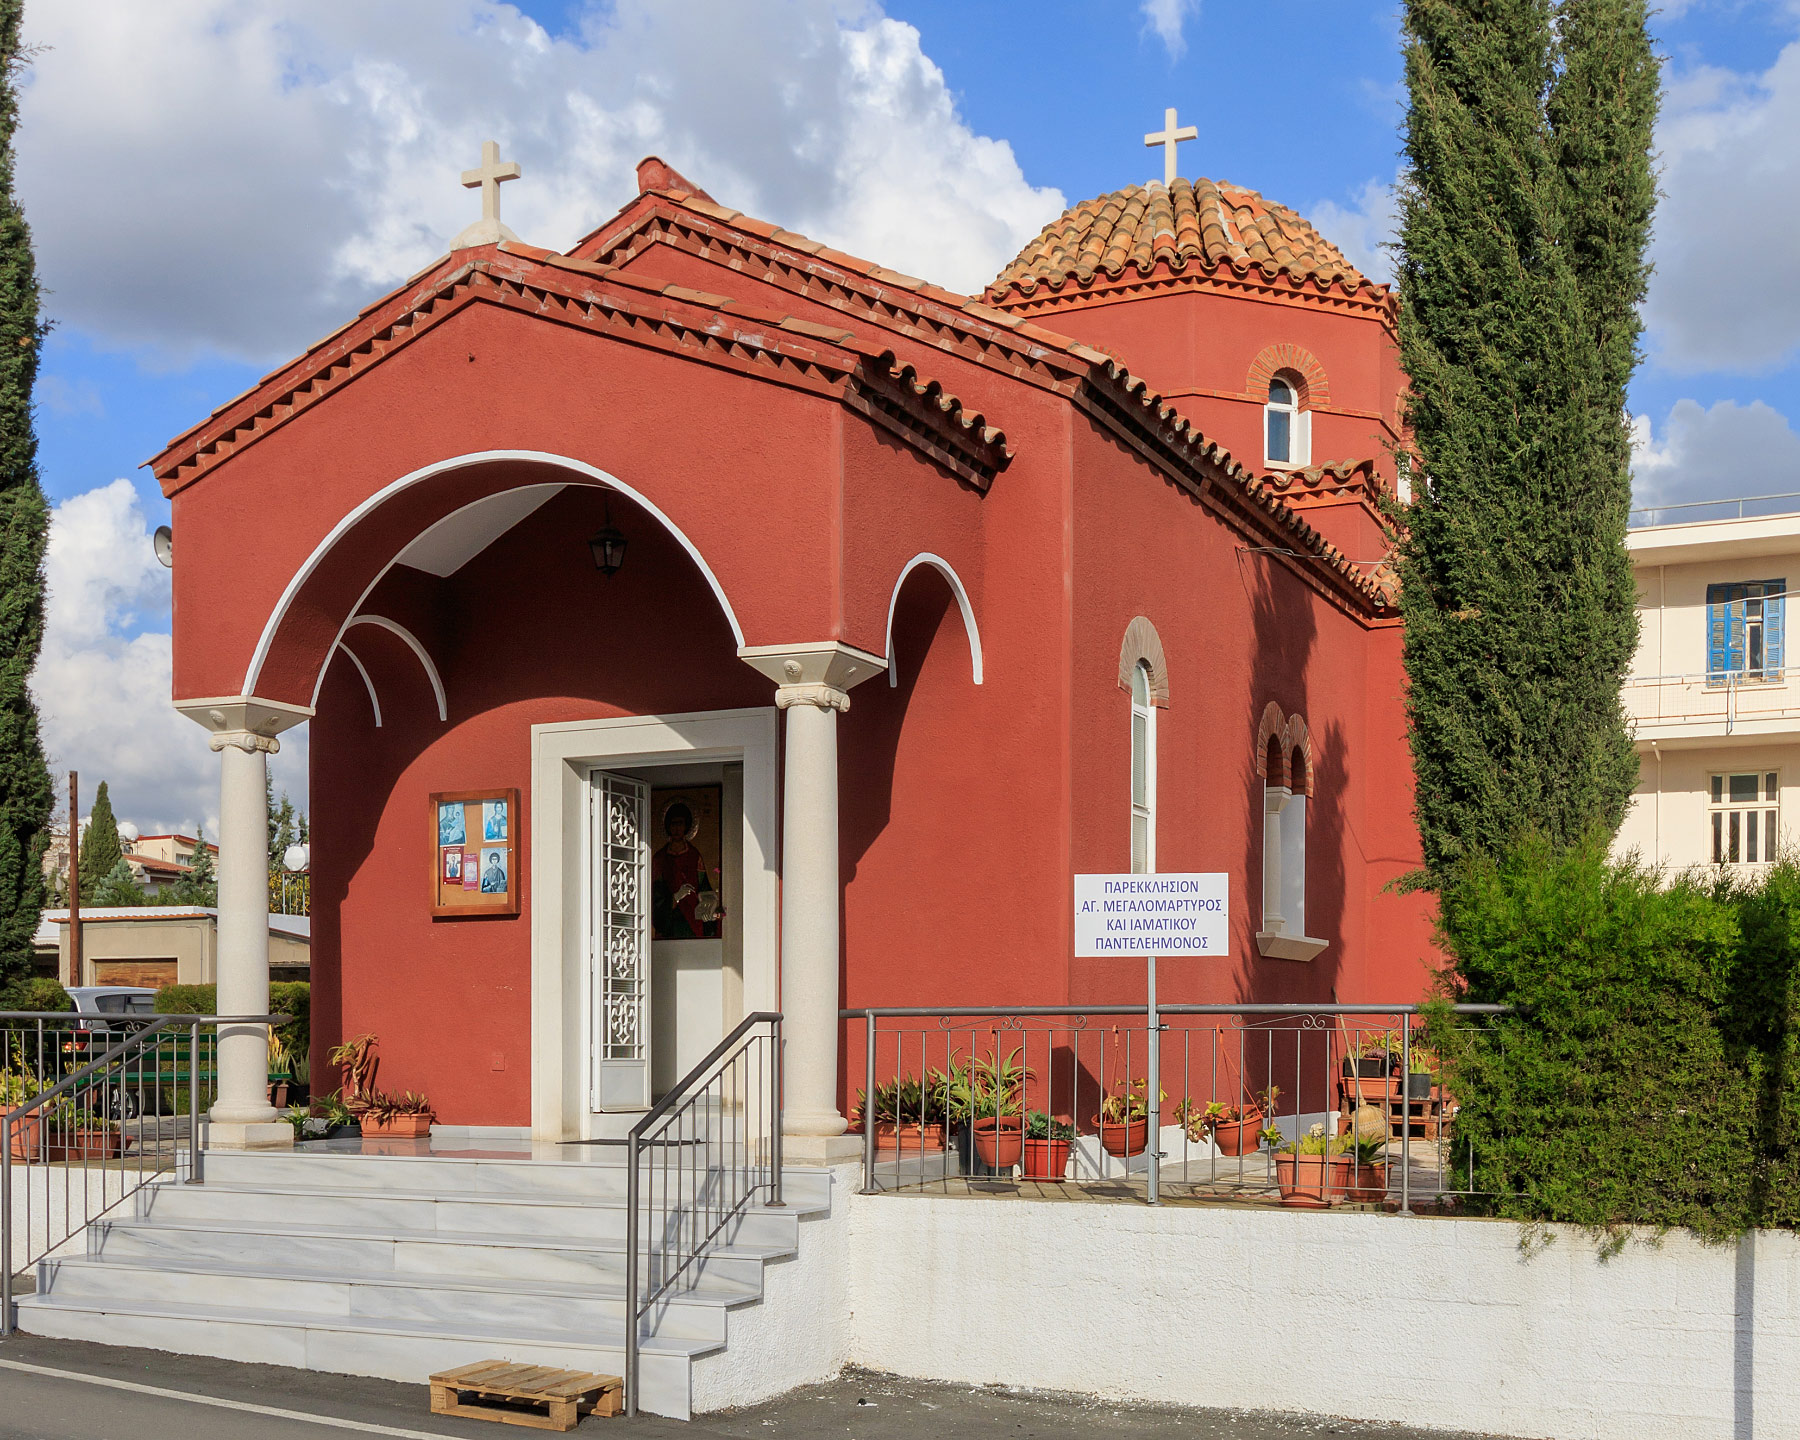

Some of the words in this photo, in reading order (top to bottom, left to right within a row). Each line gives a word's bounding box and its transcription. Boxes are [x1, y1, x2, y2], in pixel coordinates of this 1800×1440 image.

[1104, 881, 1199, 893] ΠΑΡΕΚΚΛΗΣΙΟΝ
[1081, 900, 1100, 912] ΑΓ.
[1103, 899, 1222, 912] ΜΕΓΑΛΟΜΑΡΤΥΡΟΣ
[1106, 919, 1126, 931] ΚΑΙ
[1130, 918, 1197, 931] ΙΑΜΑΤΙΚΟΥ
[1095, 937, 1208, 949] ΠΑΝΤΕΛΕΗΜΟΝΟΣ
